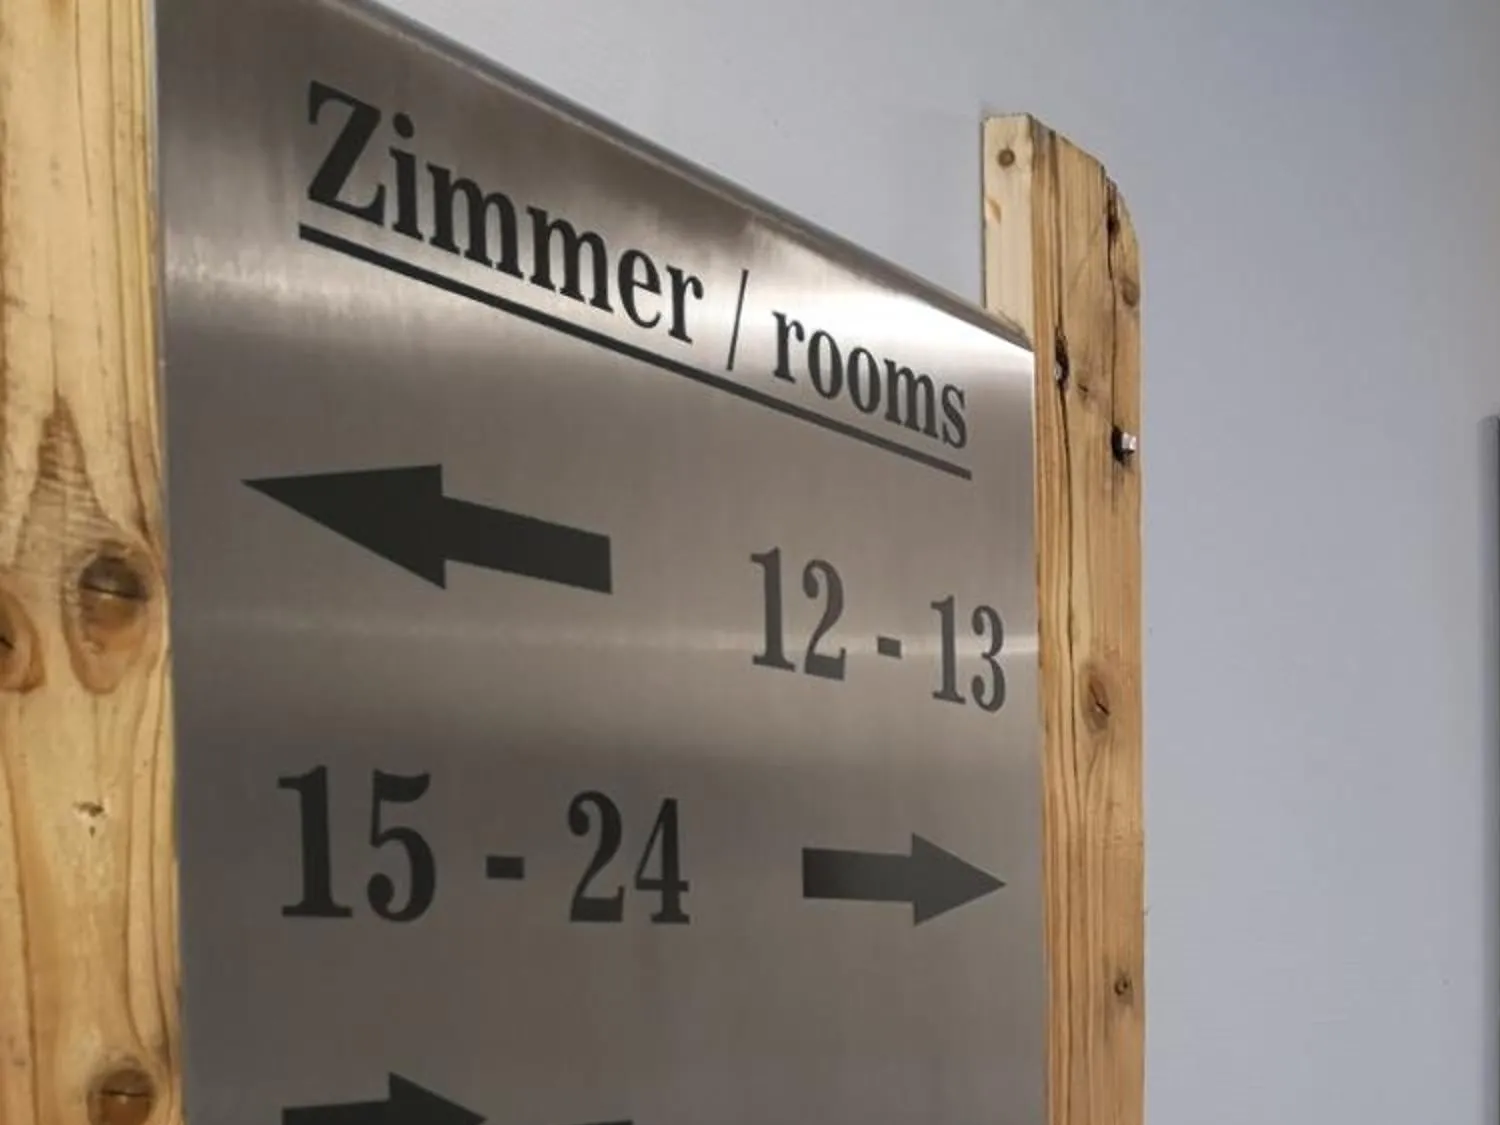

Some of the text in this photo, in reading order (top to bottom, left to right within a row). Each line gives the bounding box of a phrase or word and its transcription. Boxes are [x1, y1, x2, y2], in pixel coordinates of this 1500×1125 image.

[308, 80, 968, 448] Zimmer / rooms
[750, 547, 1007, 713] 12 - 13
[277, 765, 691, 924] 15 - 24
